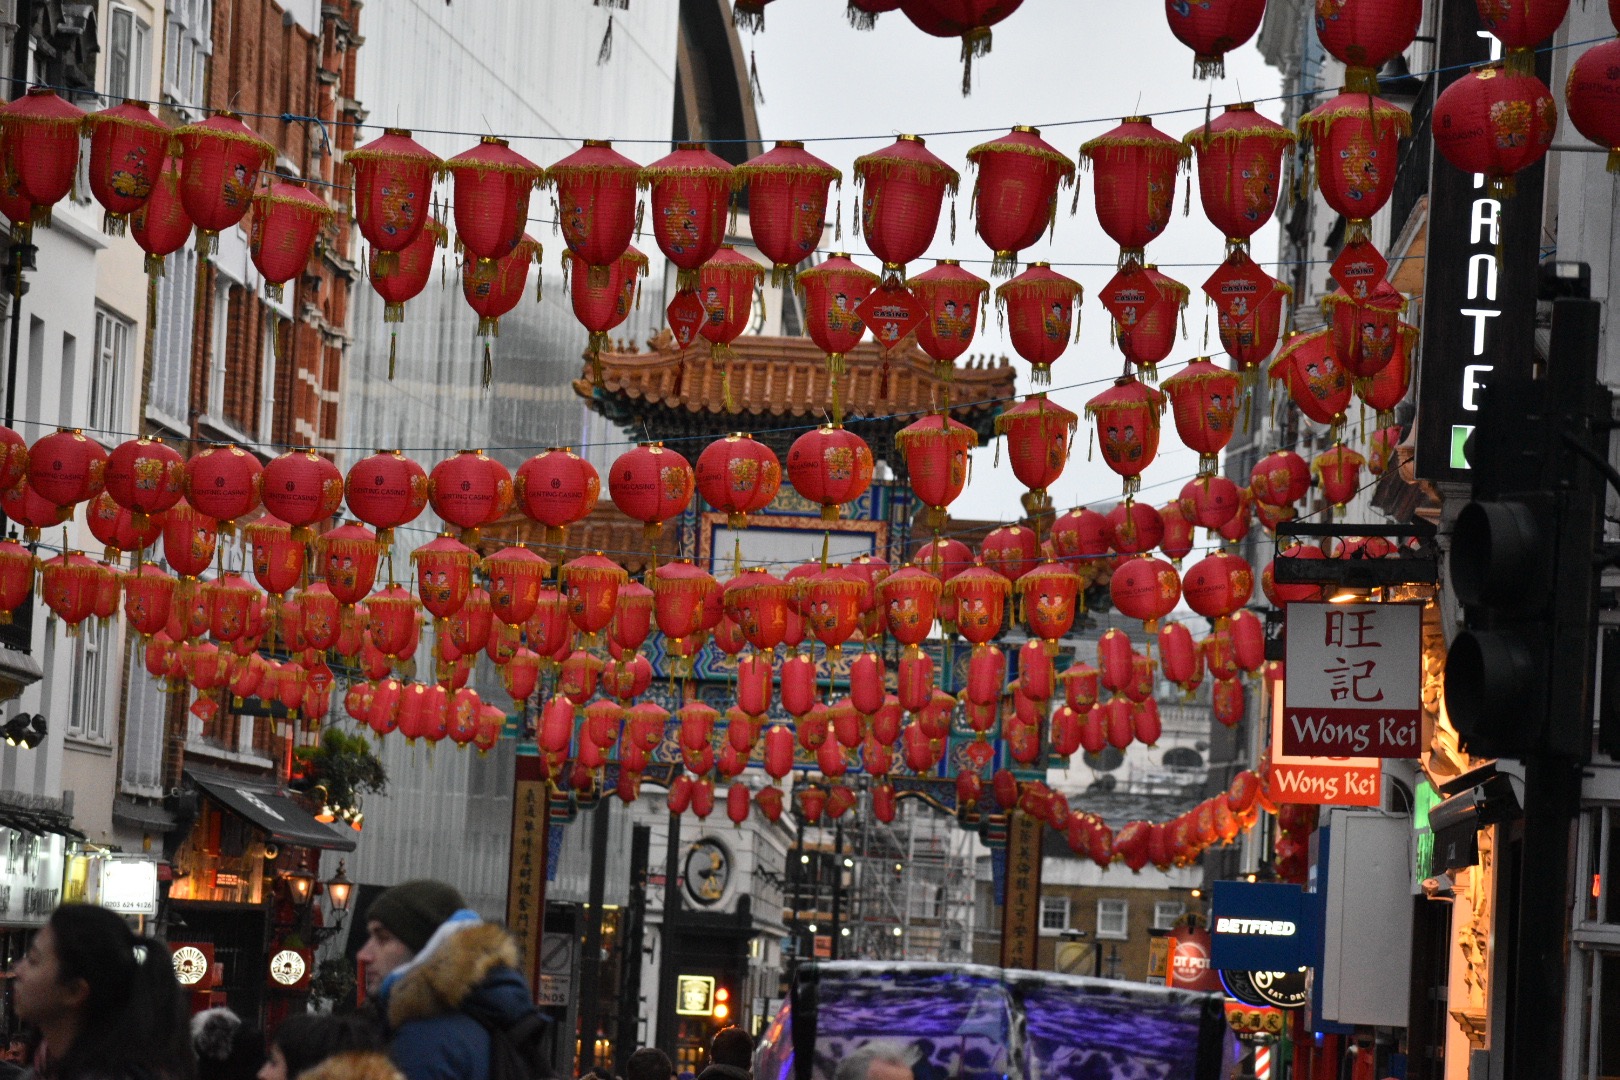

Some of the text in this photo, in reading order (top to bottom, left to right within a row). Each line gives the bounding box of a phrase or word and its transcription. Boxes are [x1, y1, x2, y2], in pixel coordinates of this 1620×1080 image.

[1345, 267, 1374, 276] CASINO
[873, 310, 909, 318] CASINO
[381, 489, 406, 497] CASINO
[559, 491, 583, 499] CASINO
[1323, 610, 1384, 702] 旺記
[1290, 714, 1416, 753] Wong Kei
[1274, 768, 1376, 800] Wong Kei
[1216, 917, 1296, 936] BETFRED
[1173, 955, 1211, 969] OT POT
[1267, 988, 1284, 1000] EAT
